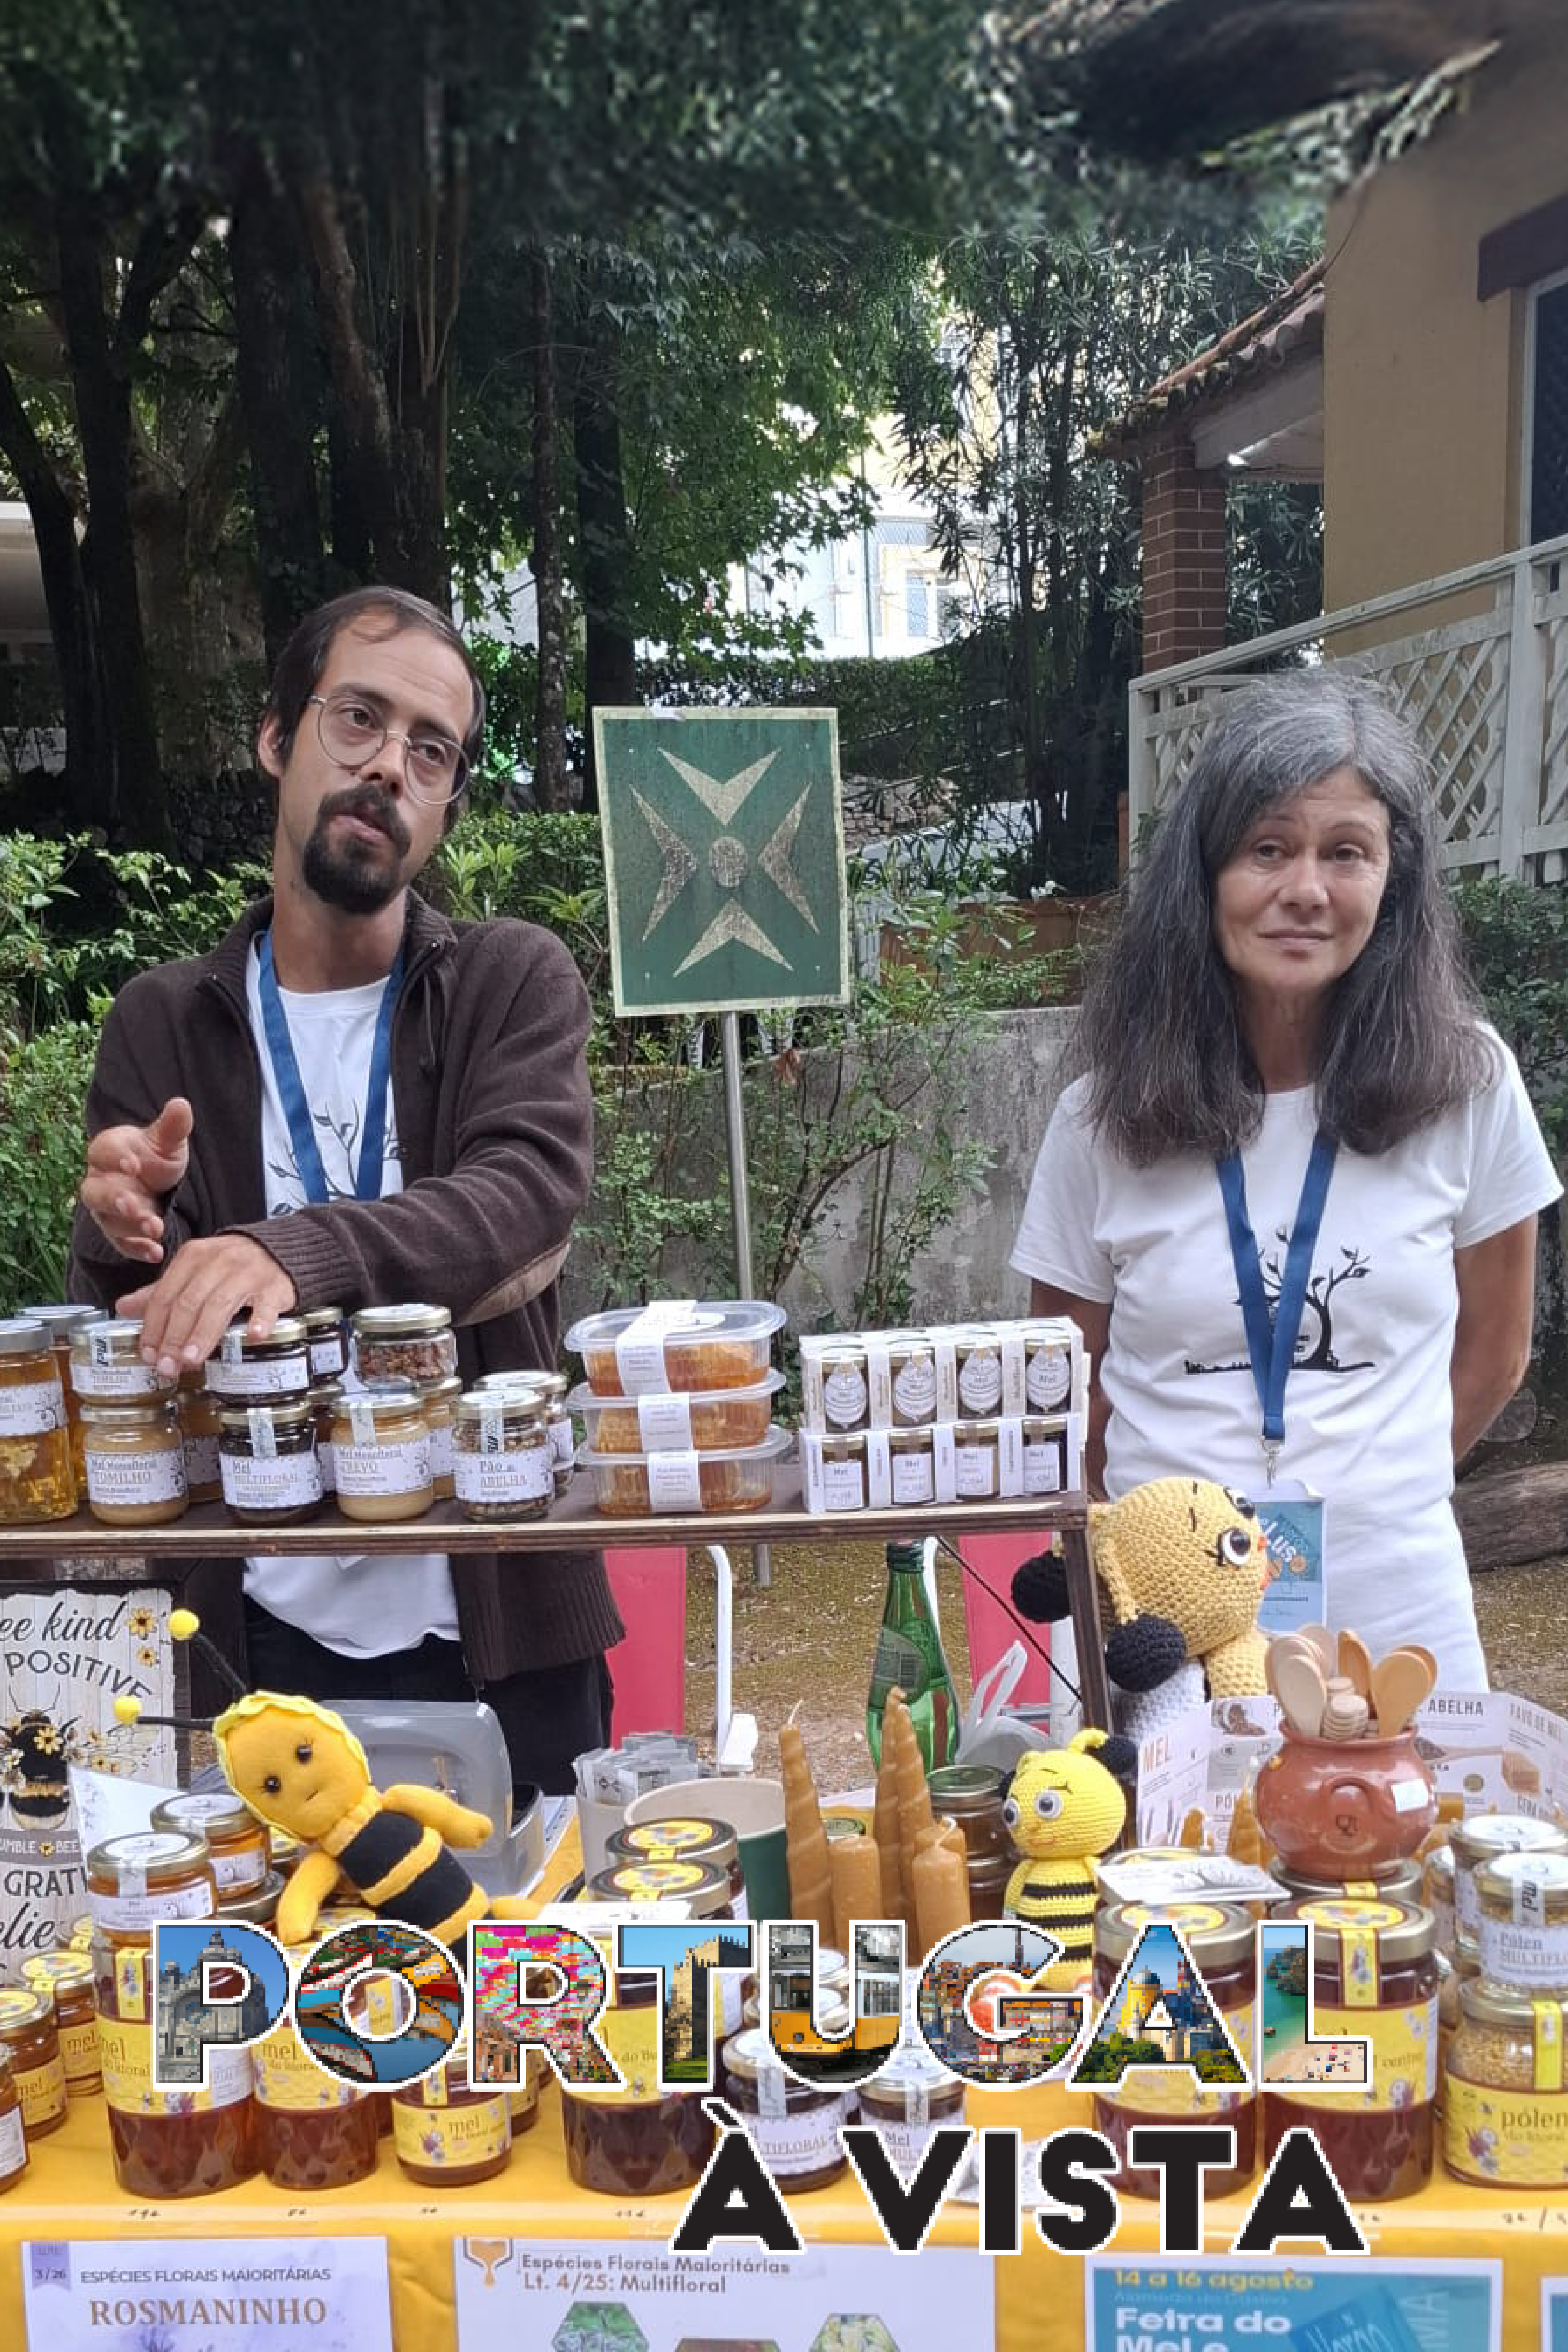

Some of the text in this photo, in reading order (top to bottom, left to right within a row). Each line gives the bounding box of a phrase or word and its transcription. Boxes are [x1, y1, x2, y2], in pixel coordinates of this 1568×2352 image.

[42, 1601, 127, 1642] kind
[1428, 1699, 1485, 1716] ABELHA
[1143, 1732, 1171, 1773] MEL
[3, 1865, 87, 1898] GRAT
[1500, 1931, 1543, 1951] Pólen
[263, 2040, 297, 2061] mel
[1501, 2105, 1568, 2131] pólen
[885, 2129, 910, 2147] Mel
[80, 2266, 332, 2284] ESPÉCIES FLORAIS MAIORITÁRIAS
[521, 2254, 791, 2275] Espécies Florais Maioritárias
[524, 2272, 726, 2296] Lt. 4/25: Multifloral
[1114, 2268, 1314, 2294] 14 a 16 agosto
[89, 2296, 328, 2326] ROSMANINHO
[1116, 2307, 1292, 2335] Feira do
